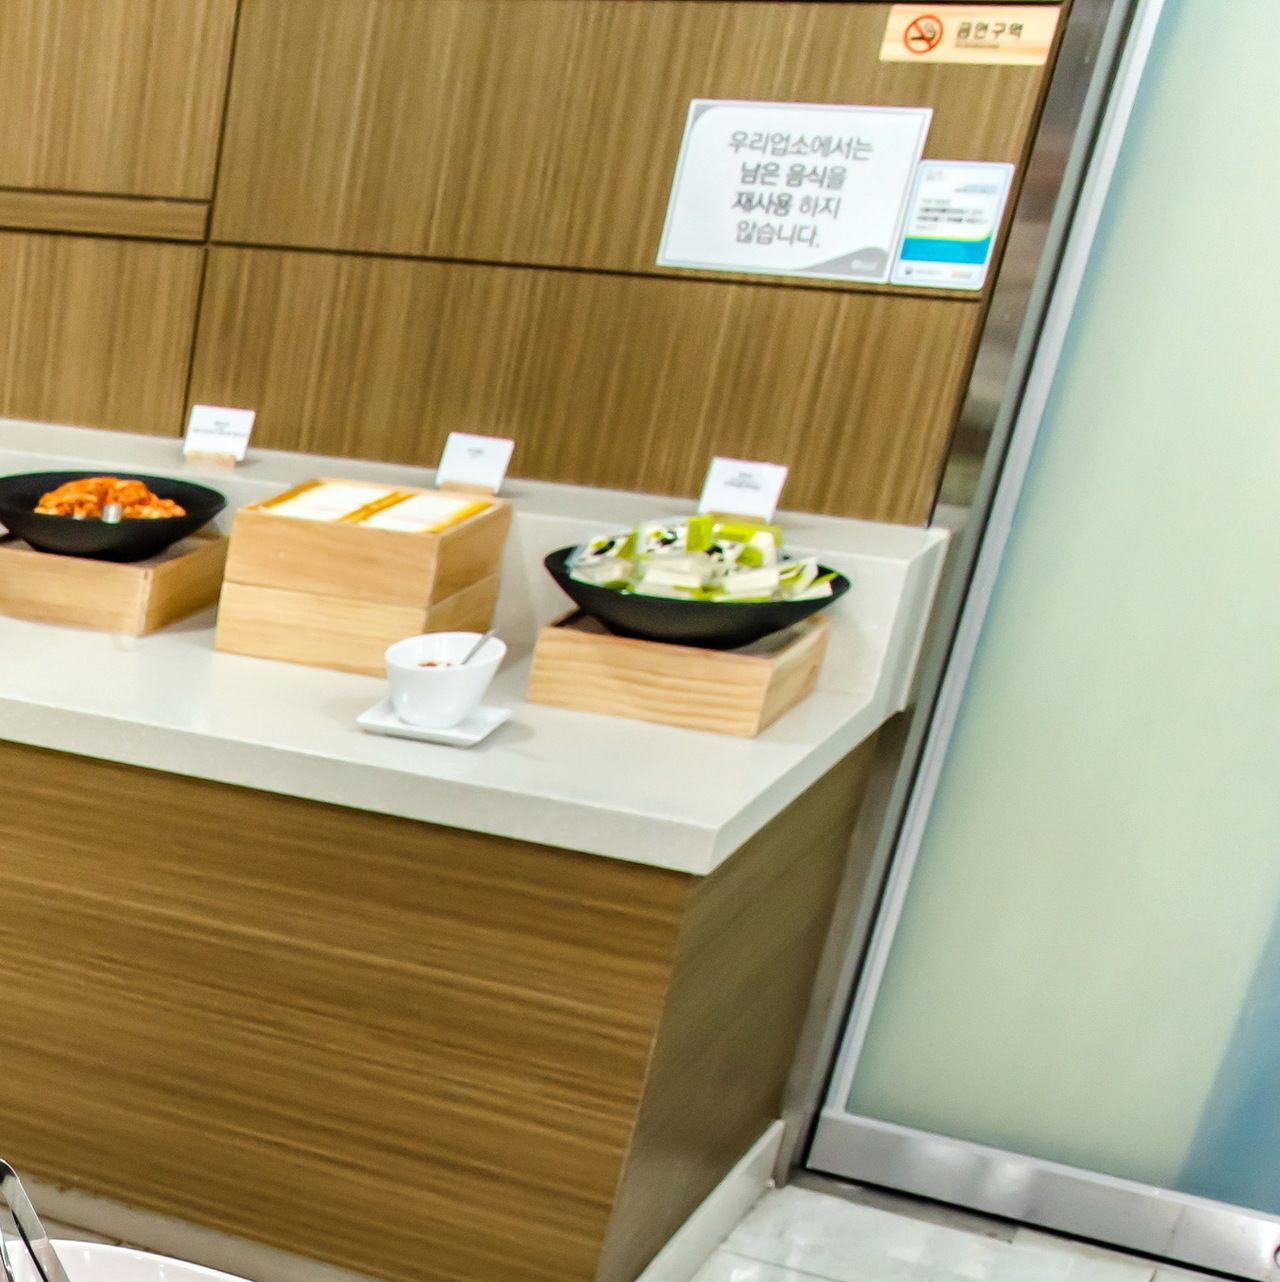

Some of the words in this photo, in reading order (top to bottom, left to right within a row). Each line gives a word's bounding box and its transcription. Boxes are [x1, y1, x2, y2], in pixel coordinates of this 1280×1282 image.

[728, 130, 873, 161] 우리업소에서는
[740, 162, 780, 186] 남은
[785, 164, 847, 190] 음식을
[732, 192, 793, 217] 재사용
[799, 195, 841, 219] 하지
[735, 220, 820, 248] 않습니다.
